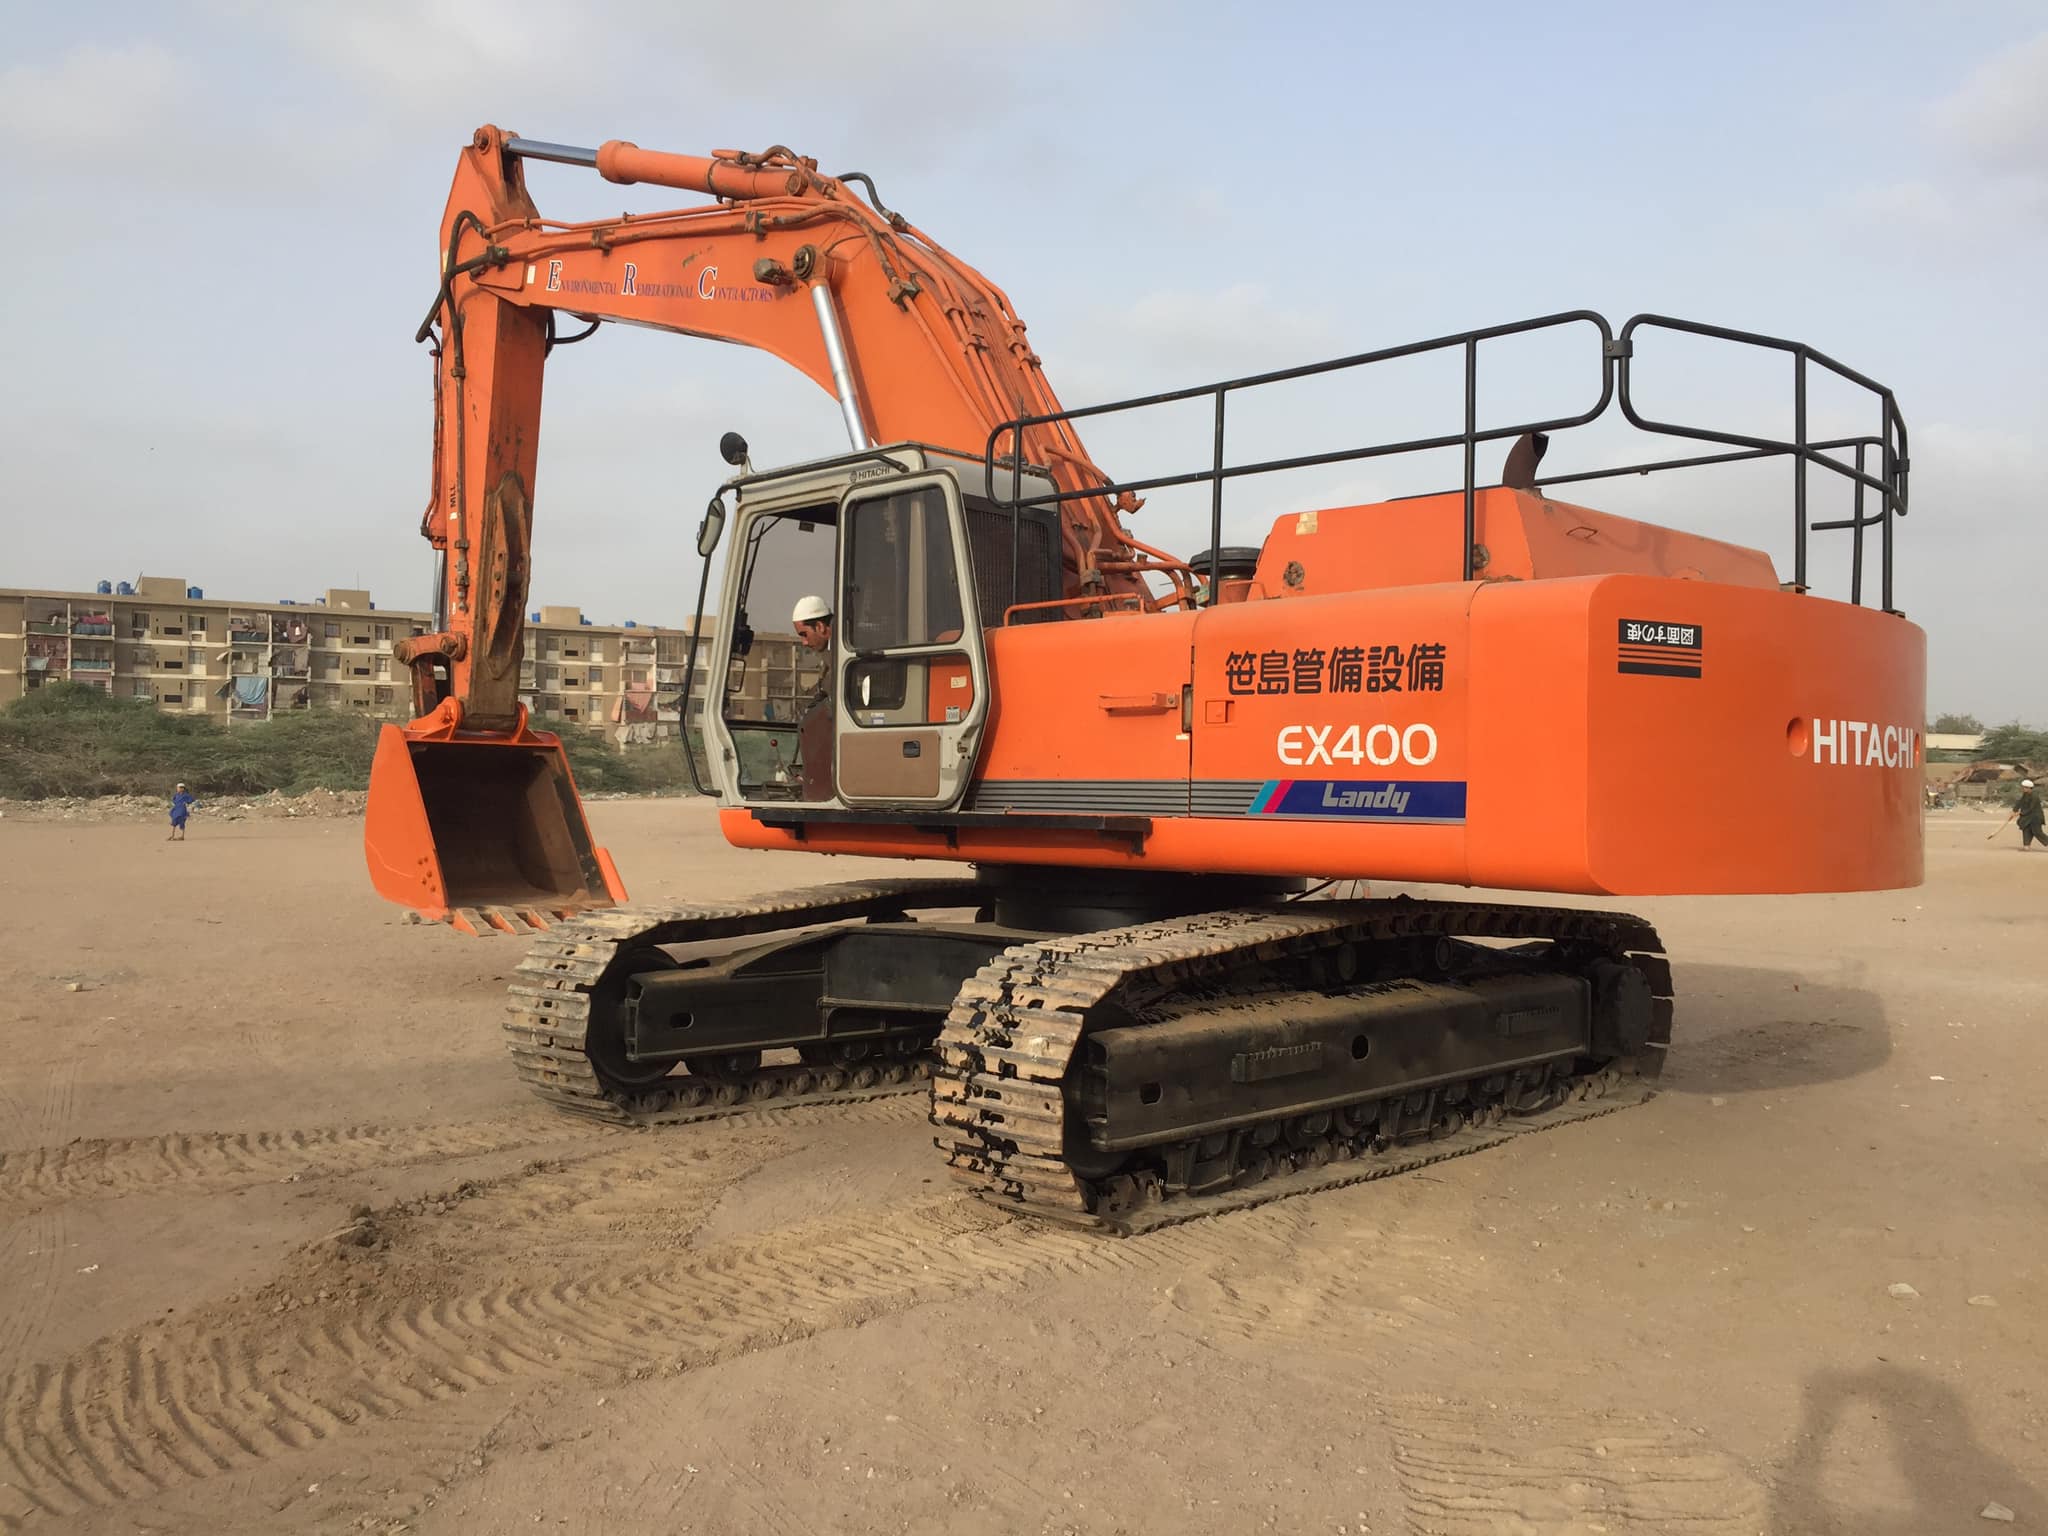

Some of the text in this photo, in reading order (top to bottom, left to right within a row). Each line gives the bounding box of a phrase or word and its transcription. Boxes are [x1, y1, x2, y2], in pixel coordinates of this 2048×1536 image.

[698, 266, 773, 303] CONTRACTORS
[858, 466, 890, 480] HITACHI
[1226, 643, 1447, 695] 笹島管備設備
[1277, 723, 1437, 766] EX400
[1812, 718, 1914, 769] HITACHI
[1322, 783, 1411, 813] Landy
